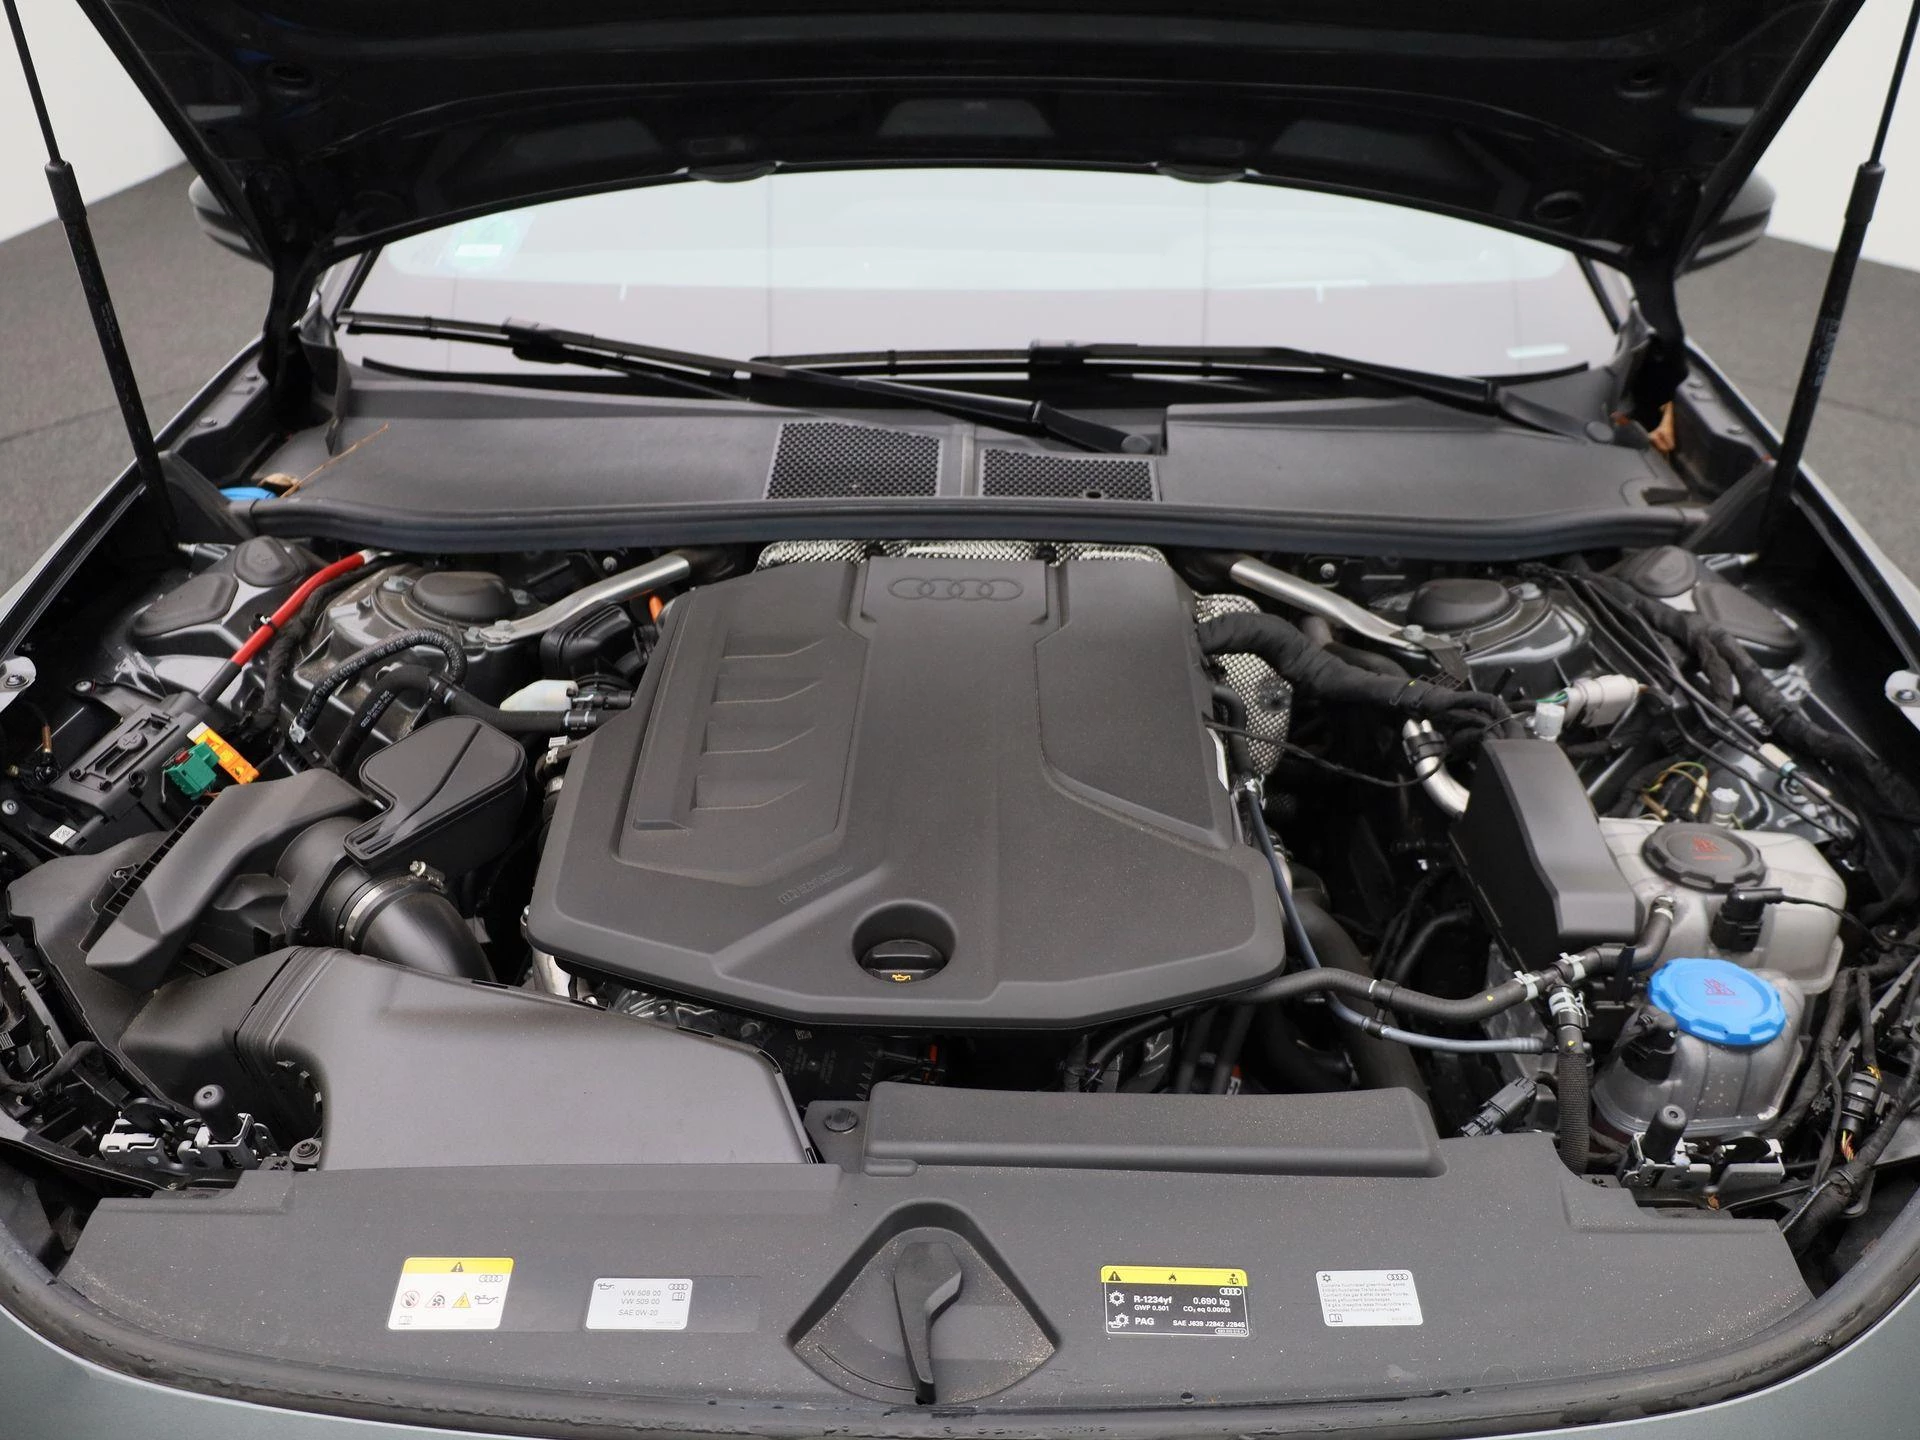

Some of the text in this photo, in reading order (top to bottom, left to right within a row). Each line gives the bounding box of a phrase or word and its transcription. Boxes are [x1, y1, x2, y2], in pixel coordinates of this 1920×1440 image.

[622, 1289, 636, 1297] VW
[652, 1289, 661, 1297] 00
[1133, 1295, 1172, 1305] R-1234yf
[1192, 1297, 1230, 1307] 0.690 kg
[1134, 1317, 1155, 1326] PAG
[1172, 1319, 1186, 1327] SAE
